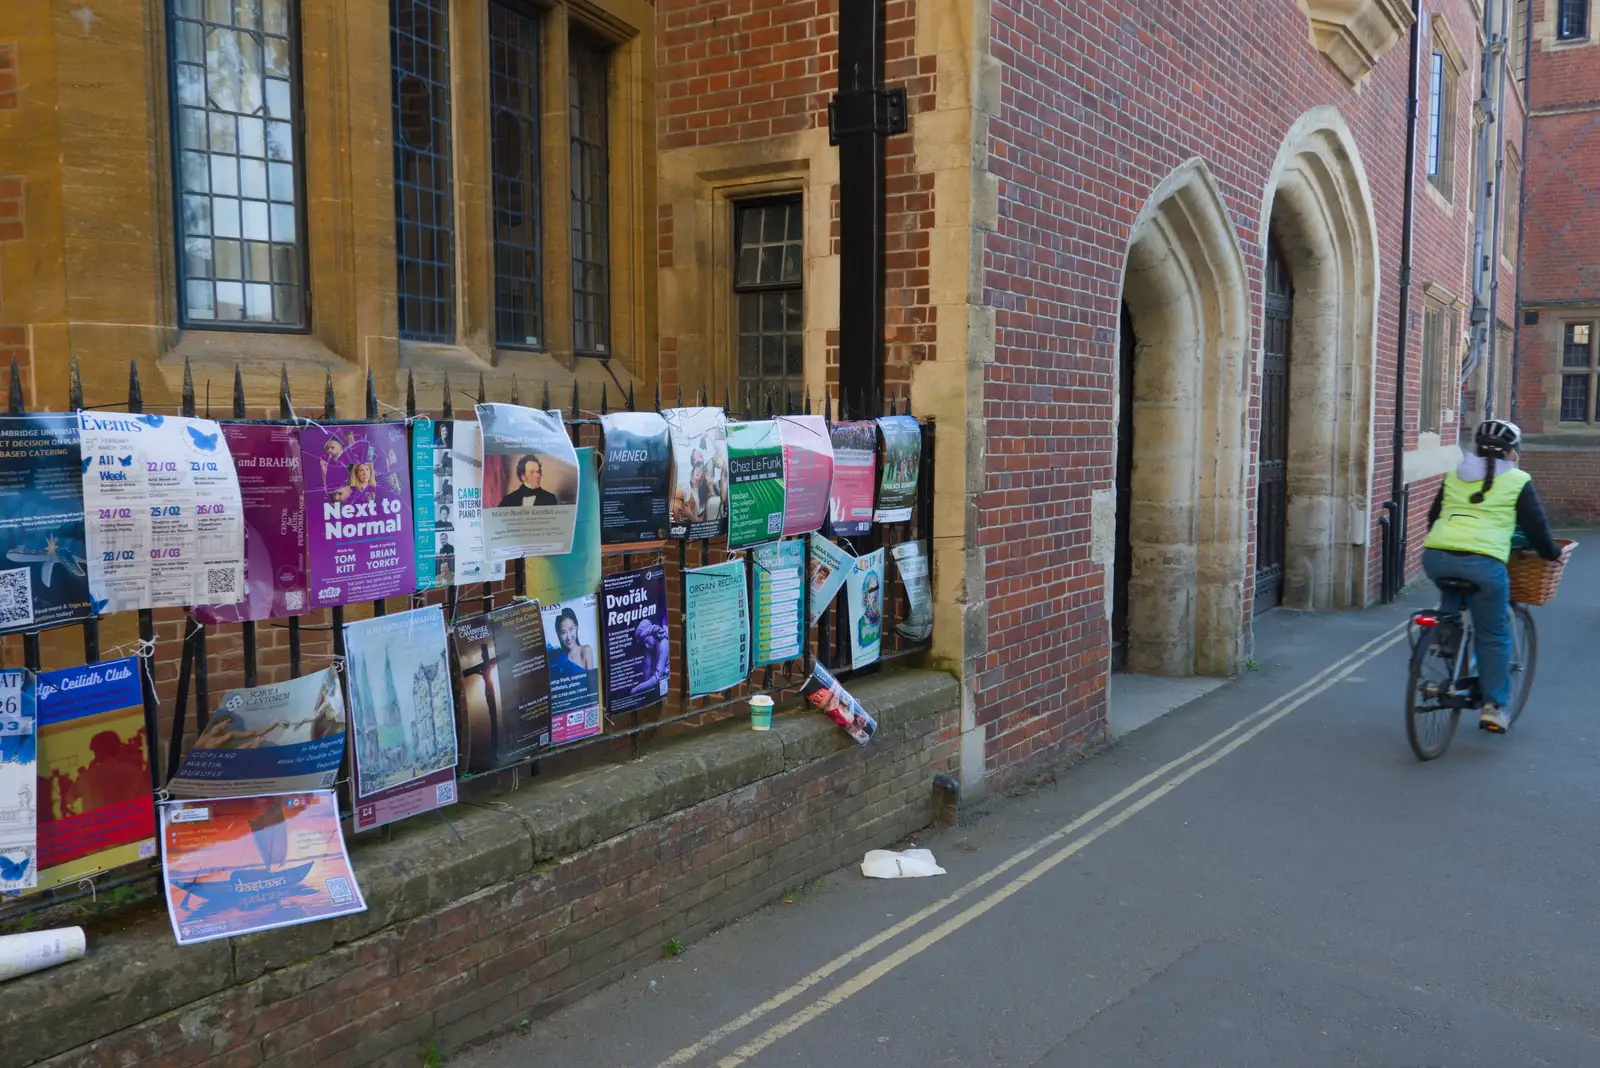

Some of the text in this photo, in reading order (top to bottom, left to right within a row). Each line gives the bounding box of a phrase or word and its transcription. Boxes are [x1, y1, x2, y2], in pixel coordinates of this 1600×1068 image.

[80, 414, 143, 432] Events
[0, 429, 39, 437] MBRIDGE
[494, 435, 541, 444] Schubert Trout
[29, 448, 68, 457] CATERING
[608, 449, 648, 462] IMENEO
[98, 455, 114, 466] All
[238, 457, 300, 468] and BRAHMS
[730, 456, 782, 474] Chez Le Funk
[99, 470, 127, 481] Week
[323, 498, 401, 521] Next to
[458, 509, 476, 519] PIANO
[325, 514, 402, 540] Normal
[740, 518, 764, 527] SEPTEMBER
[370, 548, 396, 560] BRIAN
[815, 545, 827, 555] MAA
[334, 553, 356, 564] TOM
[366, 557, 400, 570] YORKEY
[336, 563, 356, 574] KITT
[689, 582, 716, 594] ORGAN
[717, 574, 743, 588] RECITALS
[606, 587, 648, 609] Dvořák
[492, 605, 537, 623] Seven Last Words
[608, 603, 657, 626] Requiem
[501, 612, 539, 628] from the Cross
[458, 624, 472, 633] NEW
[459, 625, 489, 639] CAMBRIDGE
[467, 631, 490, 643] SINGERS
[61, 672, 104, 691] Ceilidh
[105, 666, 132, 682] Club
[571, 673, 587, 681] soprano
[568, 681, 581, 689] piano
[249, 687, 280, 697] SCHOLA
[246, 692, 291, 706] CANTORUM
[192, 751, 237, 760] COPLAND
[306, 752, 327, 761] Double
[186, 759, 341, 769] MARTIN Requiem
[362, 807, 373, 817] £4
[234, 876, 287, 893] dastaan
[191, 925, 228, 936] CAMBRIDGE
